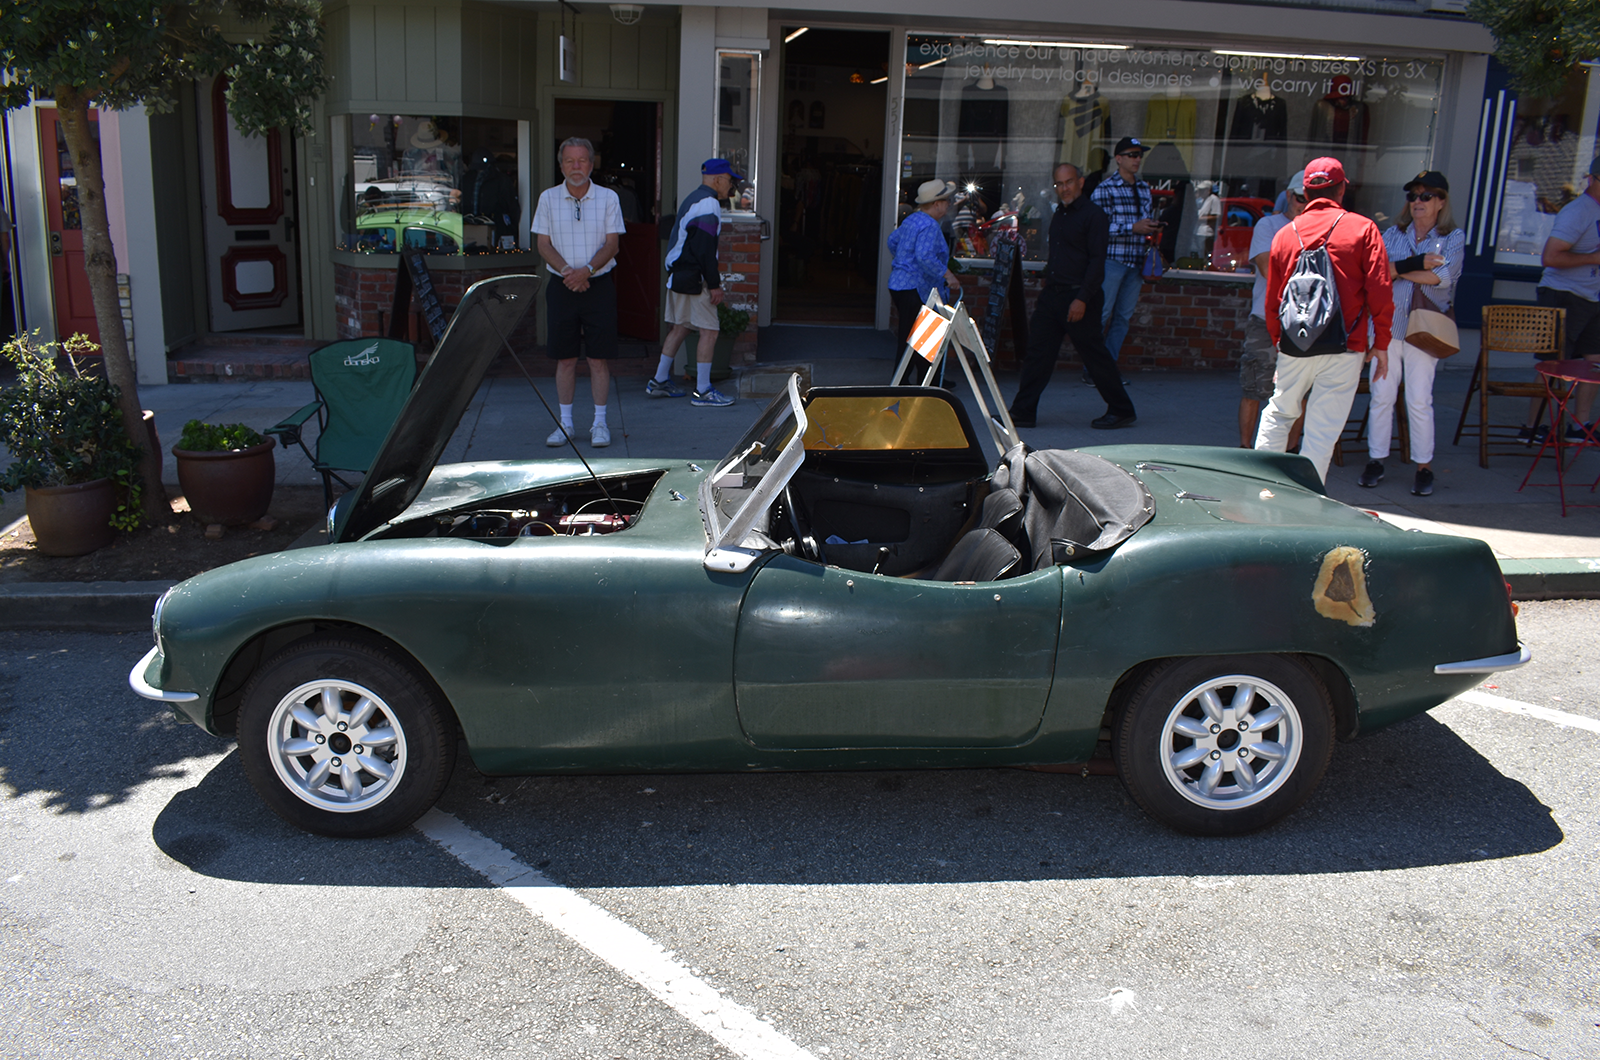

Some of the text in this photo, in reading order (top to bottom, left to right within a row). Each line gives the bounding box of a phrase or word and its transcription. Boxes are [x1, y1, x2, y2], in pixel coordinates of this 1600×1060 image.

[920, 42, 1428, 79] experience our unique women's clothing in sizes XS to 3X
[963, 62, 1193, 89] jewelry by local designers
[1238, 77, 1360, 97] we carry it all
